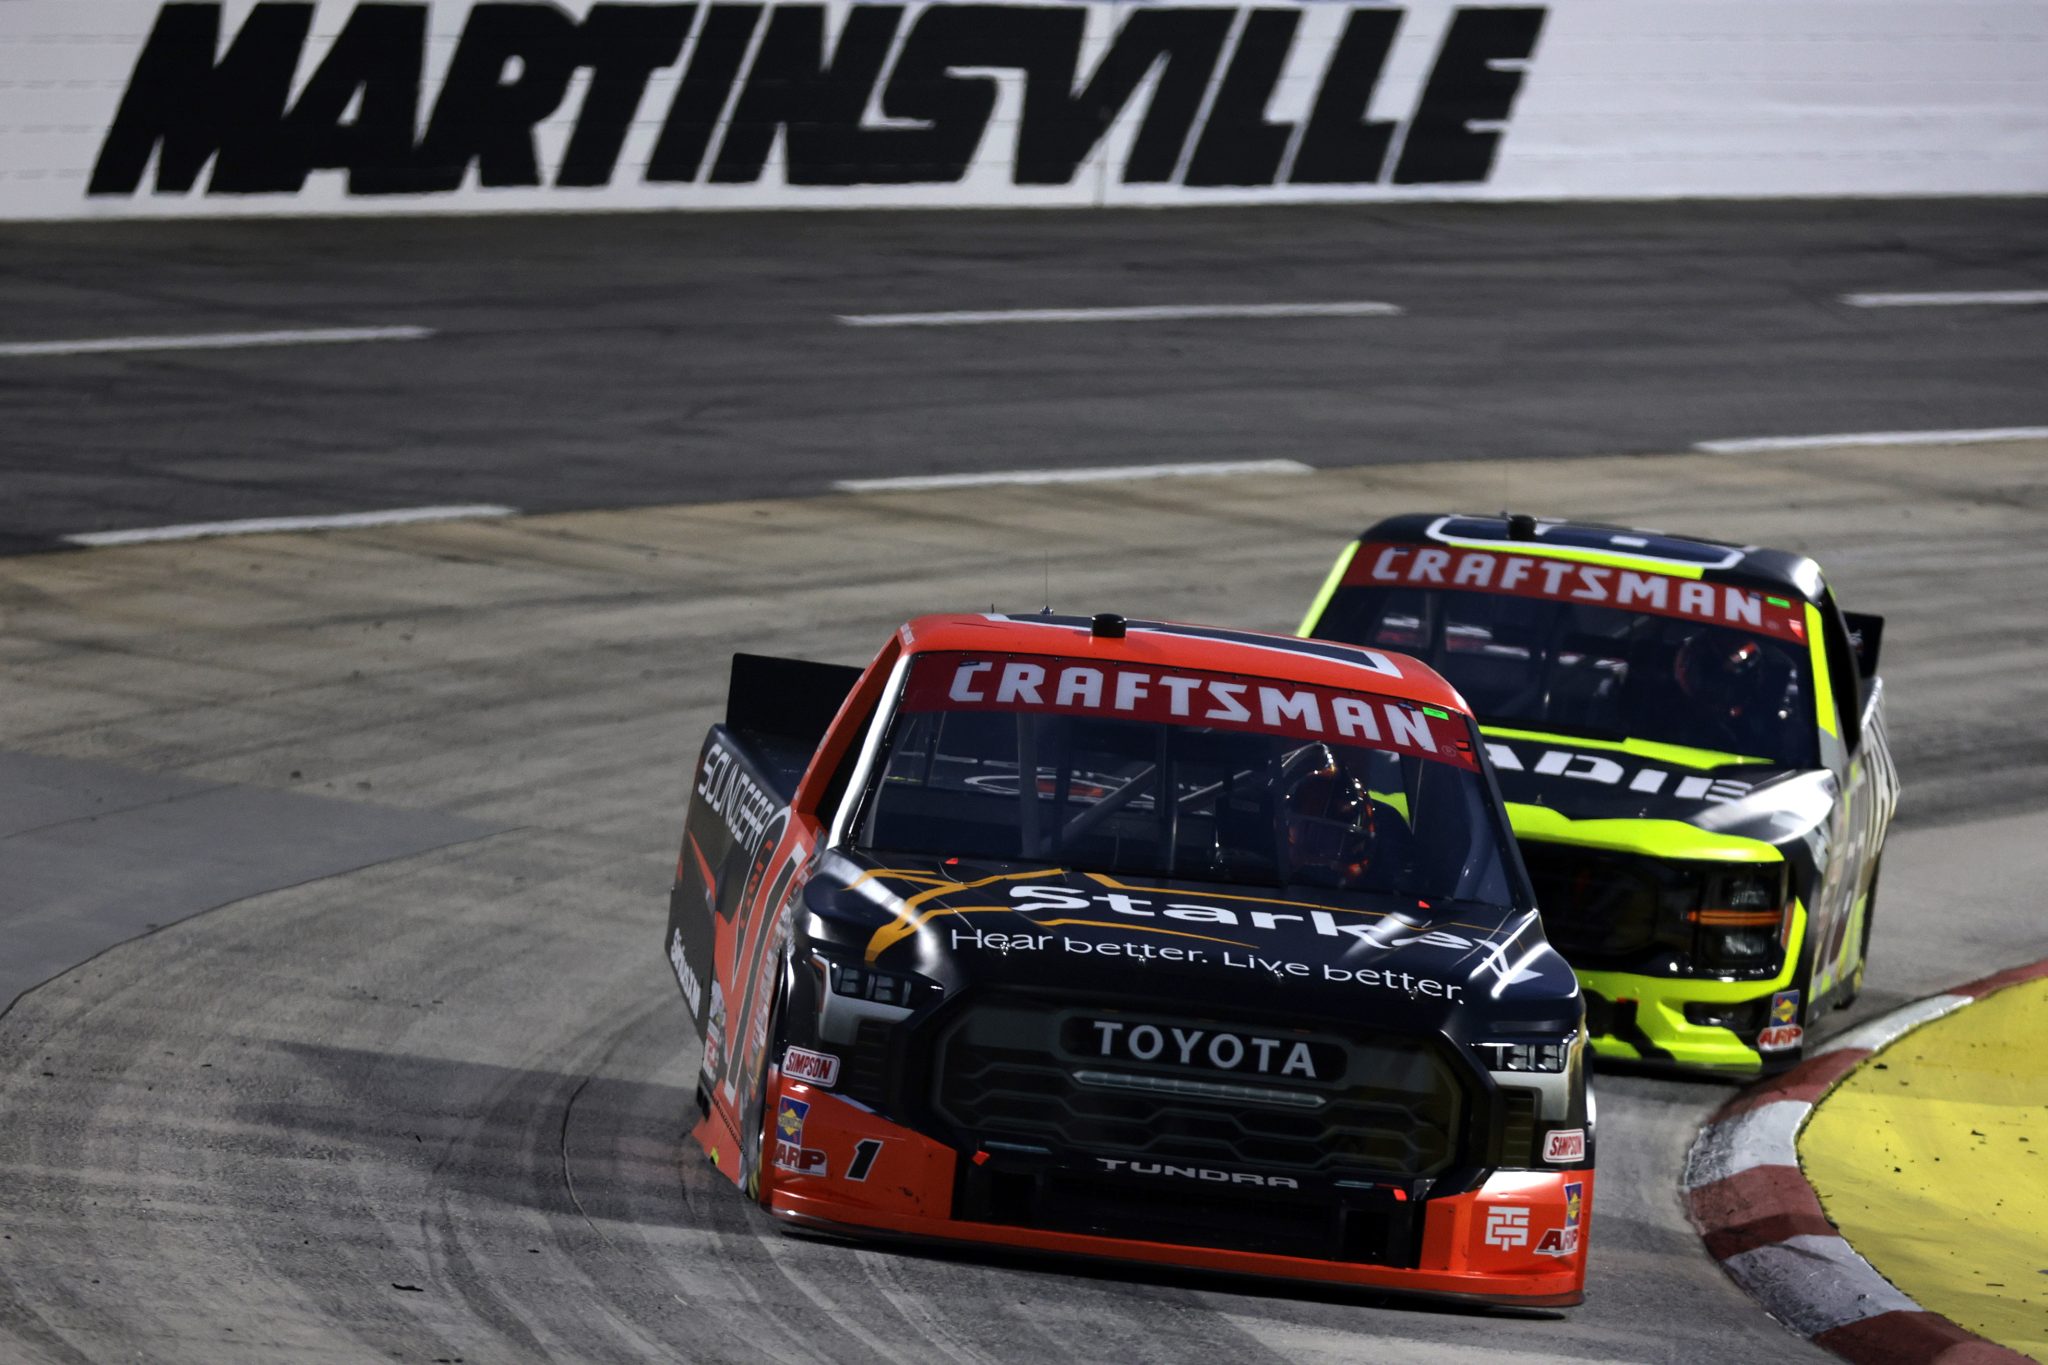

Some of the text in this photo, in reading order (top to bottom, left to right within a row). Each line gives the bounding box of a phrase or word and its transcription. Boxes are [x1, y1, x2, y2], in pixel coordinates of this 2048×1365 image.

[84, 2, 1550, 196] MARTINSVILLE
[1371, 547, 1763, 627] CRAFTSMAN
[948, 661, 1438, 754] CRAFTSMAN
[698, 743, 775, 856] SOUNDGEAR
[951, 928, 1464, 1005] Hear better. Live better.
[786, 1051, 832, 1079] SIMPSON
[1094, 1021, 1317, 1078] TOYOTA
[773, 1141, 827, 1171] ARP
[844, 1138, 884, 1182] 1
[1096, 1157, 1298, 1188] TUNDRA
[1550, 1136, 1582, 1156] SIMPSON
